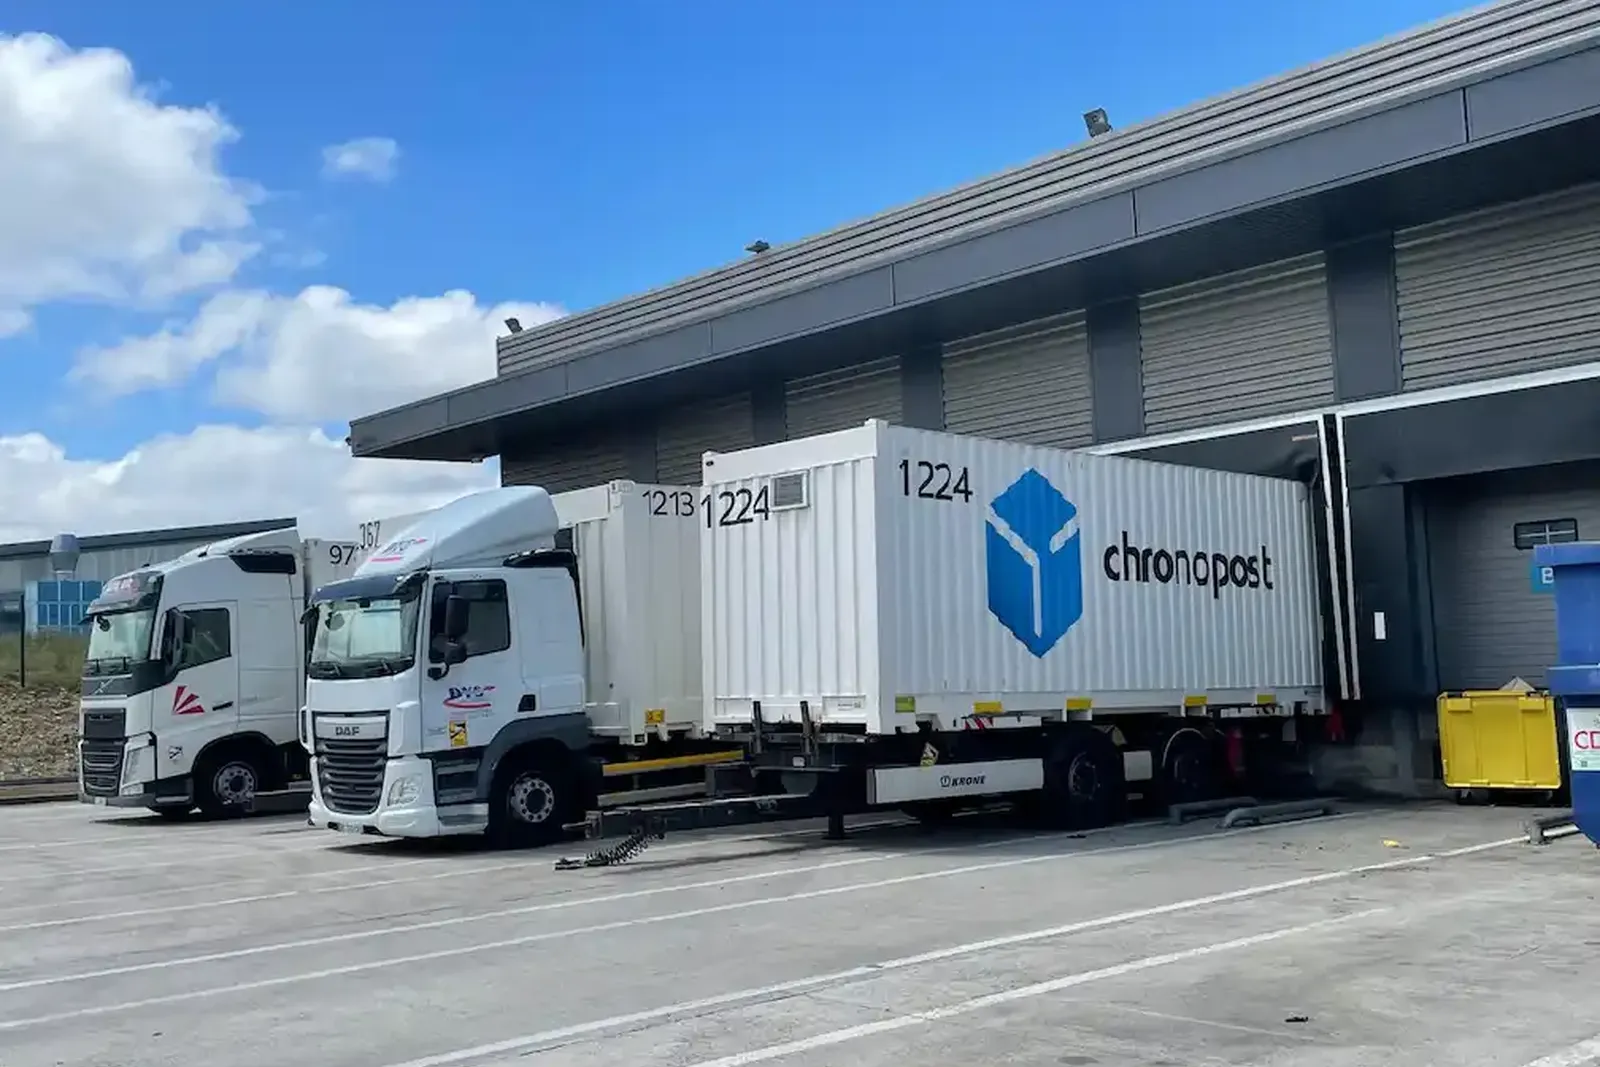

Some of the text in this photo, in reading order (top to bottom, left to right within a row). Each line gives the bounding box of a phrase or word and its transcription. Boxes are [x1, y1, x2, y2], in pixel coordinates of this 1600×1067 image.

[899, 459, 974, 503] 1224
[642, 490, 695, 517] 1213
[700, 485, 771, 529] 1224
[329, 545, 359, 566] 97
[1103, 530, 1274, 599] chronopost
[335, 726, 360, 736] DAF
[951, 775, 986, 787] KRONE
